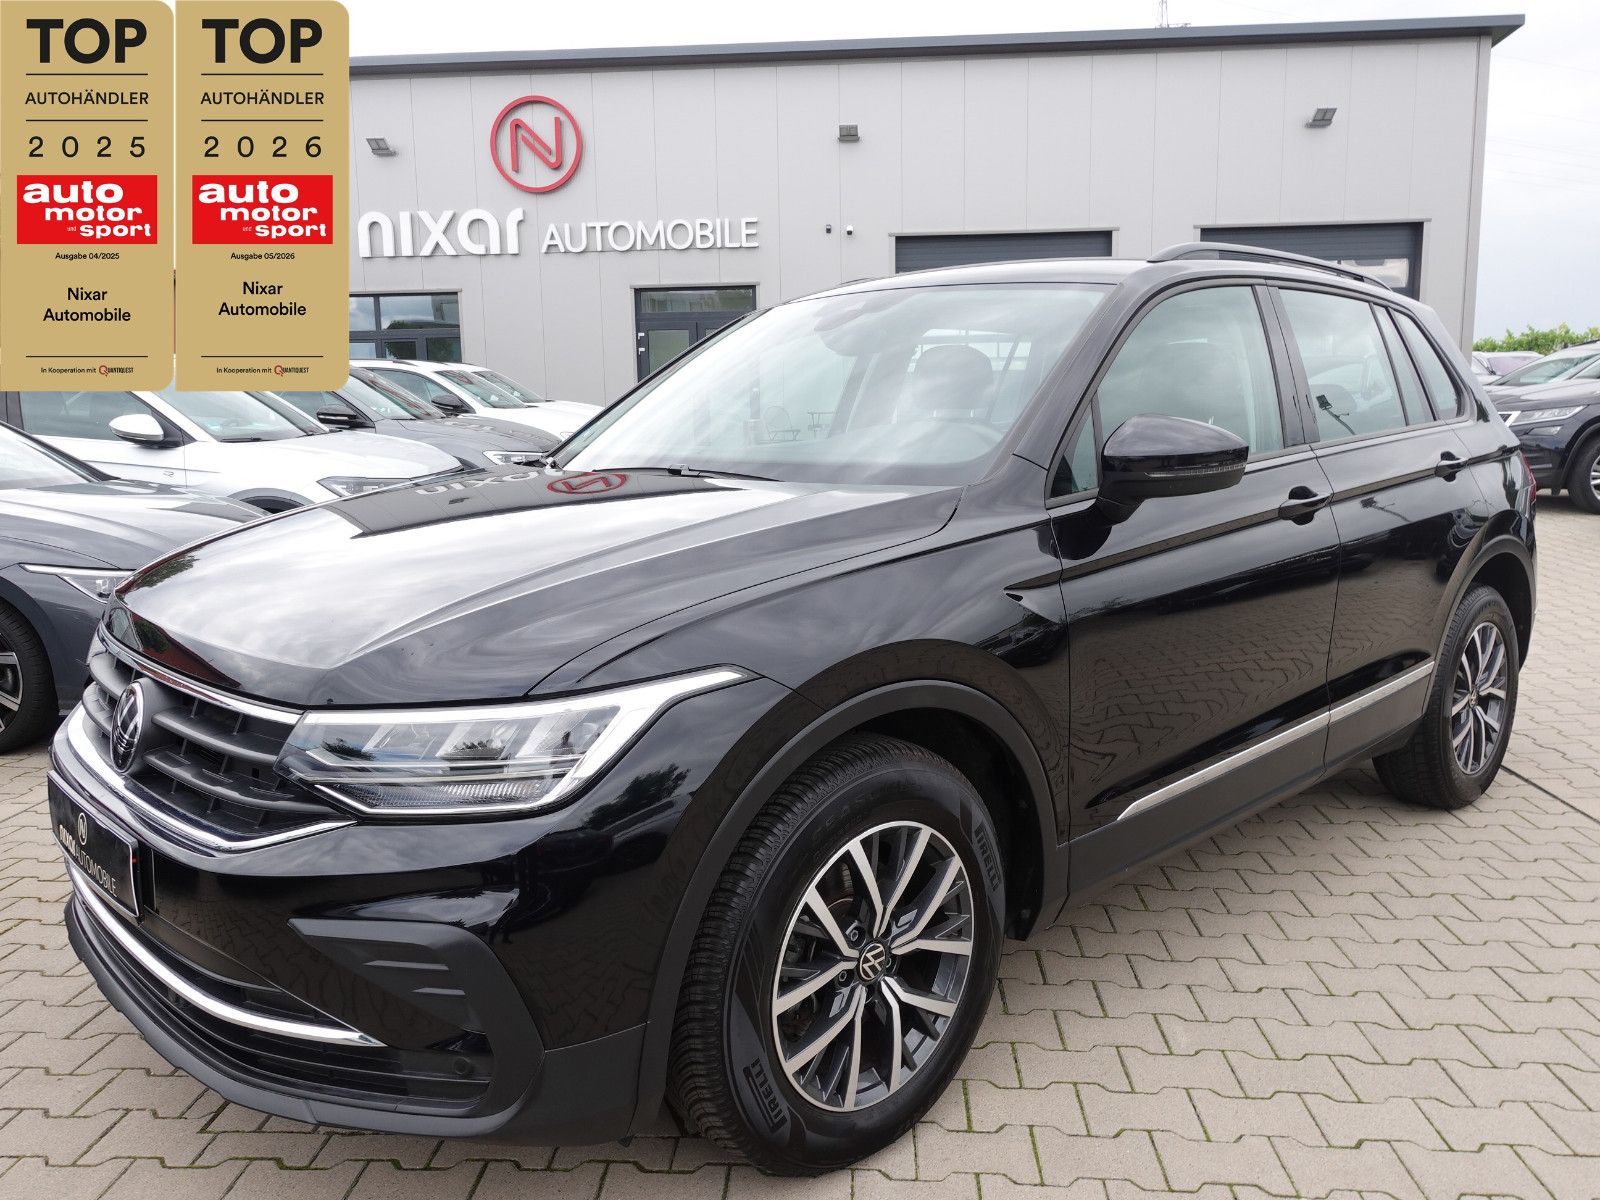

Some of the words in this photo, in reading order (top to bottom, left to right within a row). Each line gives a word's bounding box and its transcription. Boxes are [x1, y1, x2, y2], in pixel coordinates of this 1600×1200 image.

[357, 208, 526, 258] nixar
[541, 217, 759, 254] AUTOMOBILE
[75, 844, 118, 897] AUTOMOBILE
[974, 820, 1001, 892] PIRELLI
[742, 1057, 788, 1134] PIRELLI
